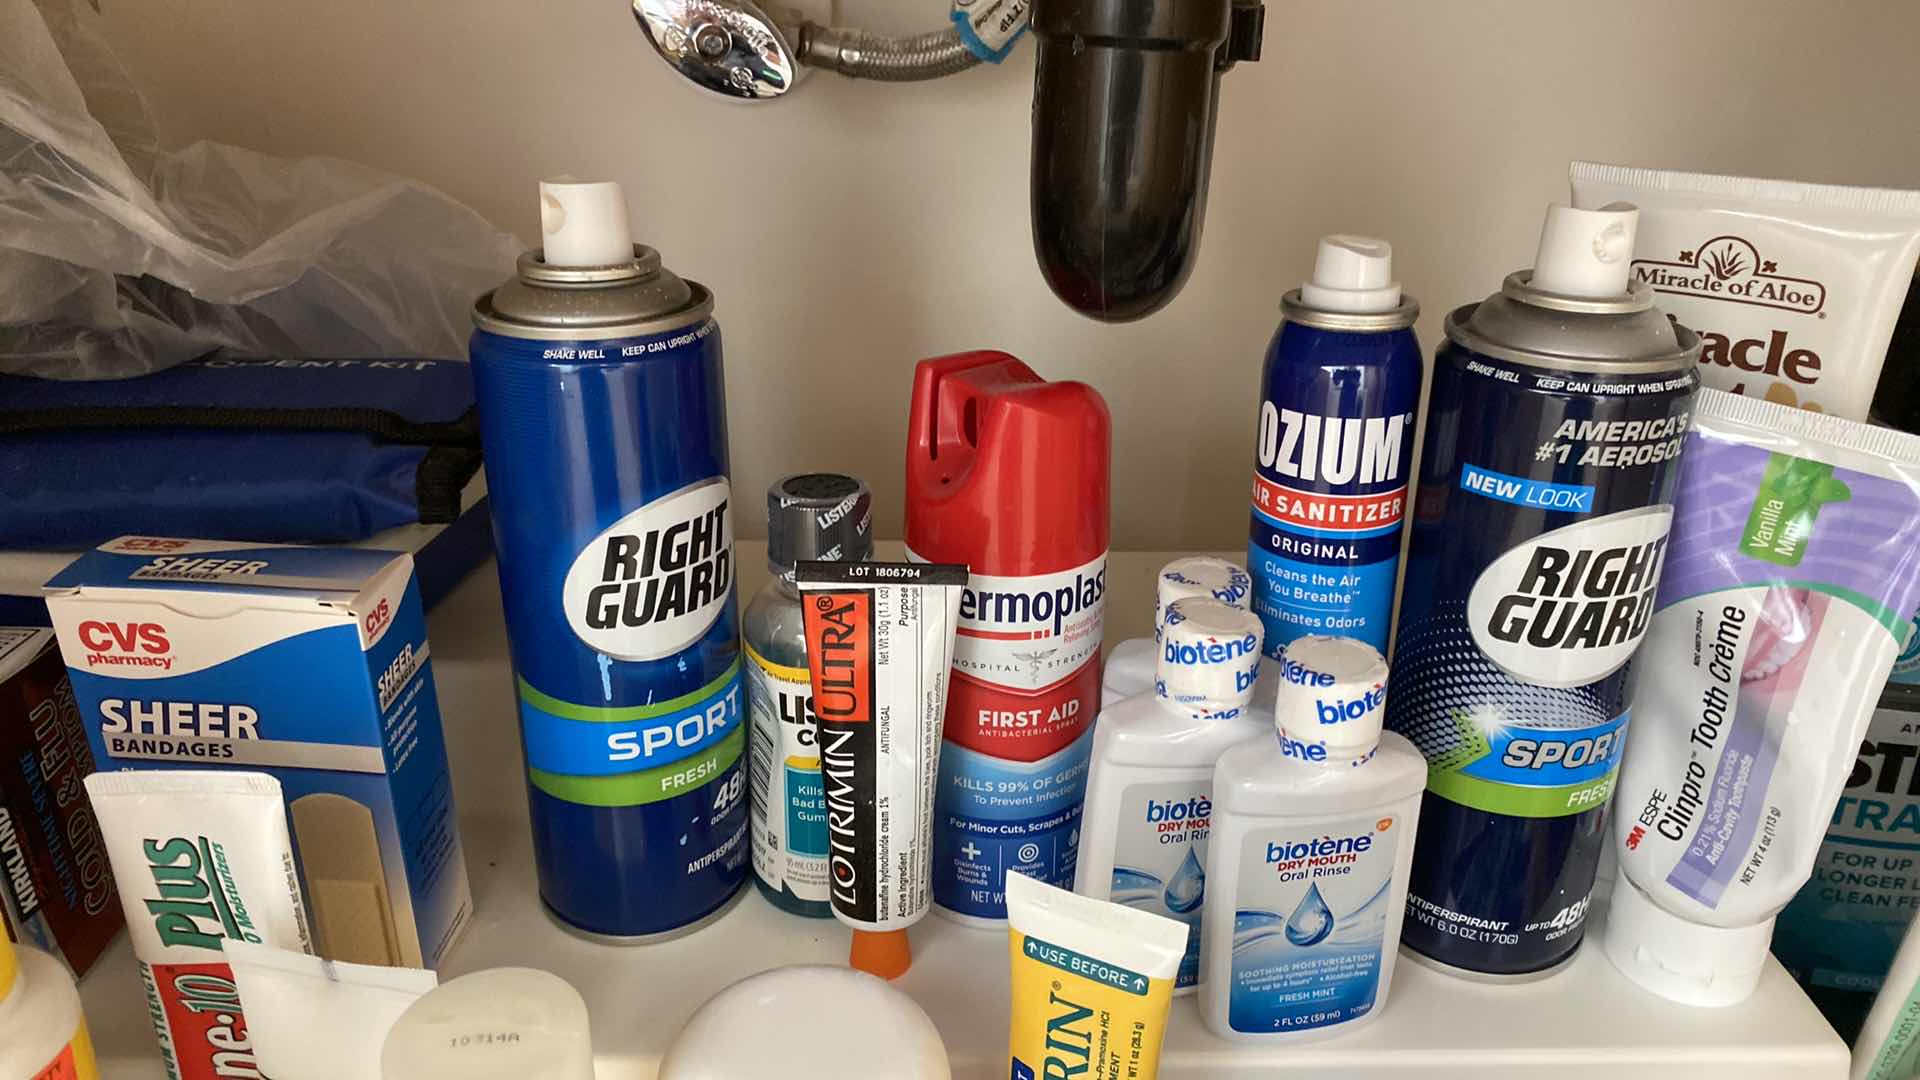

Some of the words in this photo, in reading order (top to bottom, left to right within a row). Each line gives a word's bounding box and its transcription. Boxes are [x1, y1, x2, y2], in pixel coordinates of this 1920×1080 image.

[1635, 266, 1723, 293] Miracle
[1728, 280, 1759, 298] of
[1757, 282, 1816, 307] Aloe
[543, 349, 576, 360] SHAKE
[577, 349, 606, 360] WELL
[621, 345, 647, 357] KEEP
[647, 341, 667, 353] CAN
[667, 333, 696, 349] UPRIGHT
[1465, 360, 1496, 379] SHAKE
[1494, 370, 1520, 384] WELL
[1536, 377, 1565, 390] KEEP
[1566, 381, 1590, 394] CAN
[1592, 382, 1635, 394] UPRIGHT
[1637, 381, 1664, 394] WHEN
[1553, 412, 1689, 442] AMERICA'S
[1258, 400, 1405, 486] OZIUM
[1535, 441, 1571, 465] #1
[1577, 440, 1684, 467] AEROSOL
[1465, 471, 1521, 500] NEW
[1525, 486, 1587, 509] LOOK
[1275, 495, 1401, 524] SANITIZER
[1749, 498, 1784, 549] Vanilla
[601, 499, 728, 583] RIGHT
[1271, 533, 1359, 560] ORIGINAL
[1774, 519, 1801, 557] Mint
[144, 556, 270, 575] SHEER
[849, 567, 870, 577] LOT
[875, 567, 921, 578] 1806794
[1265, 560, 1308, 584] Cleans
[1312, 573, 1330, 587] the
[1338, 573, 1361, 587] Air
[1517, 533, 1669, 599] RIGHT
[585, 547, 729, 630] GUARD
[877, 586, 891, 600] oz)
[1268, 579, 1290, 596] You
[1293, 587, 1352, 604] Breathe
[366, 597, 390, 634] CVS
[877, 602, 892, 618] (1.1
[898, 587, 911, 627] Purpose
[1487, 586, 1657, 650] GUARD
[877, 620, 891, 637] 30g
[1325, 616, 1366, 628] Odors
[78, 620, 171, 655] CVS
[877, 638, 889, 651] Wt
[1164, 634, 1258, 666] biotène
[1708, 605, 1747, 684] Crème
[86, 653, 173, 670] pharmacy
[377, 642, 414, 693] SHEER
[821, 601, 857, 716] ULTRA
[877, 651, 889, 666] Net
[952, 657, 1022, 673] HOSPITAL
[99, 698, 261, 740] SHEER
[608, 685, 739, 761] SPORT
[978, 709, 1043, 729] FIRST
[1047, 699, 1080, 724] AID
[1690, 685, 1729, 749] Tooth
[29, 698, 70, 782] FLU
[880, 705, 890, 754] ANTIFUNGAL
[978, 727, 1053, 738] ANTIBACTERIAL
[112, 737, 234, 759] BANDAGES
[1502, 724, 1625, 770] SPORT
[661, 759, 718, 792] FRESH
[1718, 749, 1741, 790] Fluoride
[57, 775, 81, 808] &
[798, 786, 823, 797] Kills
[952, 776, 995, 793] KILLS
[997, 782, 1030, 794] 99%
[1032, 776, 1053, 791] OF
[792, 797, 815, 809] Bad
[879, 796, 890, 809] 1%
[973, 793, 988, 805] To
[990, 796, 1034, 807] Prevent
[1656, 760, 1706, 842] Clinpro
[1705, 808, 1741, 866] Anti-Cavity
[1727, 754, 1754, 808] Toothpaste
[1708, 790, 1730, 824] Sodium
[823, 728, 857, 906] LOTRIMIN
[880, 810, 890, 834] cream
[950, 817, 967, 830] For
[968, 823, 998, 835] Minor
[1000, 824, 1027, 835] Cuts,
[1028, 815, 1065, 833] Scrapes
[1157, 821, 1186, 833] DRY
[1625, 825, 1647, 851] 3M
[1639, 788, 1668, 827] ESPE
[1765, 815, 1779, 837] (113
[1159, 830, 1188, 845] Oral
[1265, 834, 1372, 865] biotène
[1761, 844, 1767, 853] 4
[1762, 836, 1772, 847] oz
[0, 806, 39, 916] KIRKLAND
[67, 807, 112, 916] COLD
[879, 834, 891, 884] hydrochloride
[953, 858, 993, 872] Disinfects
[1277, 859, 1306, 872] DRY
[1307, 853, 1358, 870] MOUTH
[1751, 851, 1763, 867] WT
[1832, 851, 1877, 869] FOR
[1883, 856, 1913, 871] UP
[211, 841, 256, 930] Moisturizers
[897, 853, 908, 893] Ingredient
[956, 874, 989, 887] Wounds
[957, 867, 981, 879] Burns
[1279, 869, 1309, 883] Oral
[1313, 866, 1351, 878] Rinse
[1739, 866, 1756, 887] NET
[1818, 867, 1907, 891] LONGER
[143, 836, 227, 952] Plus
[897, 893, 907, 918] Active
[970, 890, 990, 904] NET
[1822, 887, 1892, 907] CLEAN
[1417, 910, 1437, 928] WT
[1437, 919, 1458, 936] 6.0
[1460, 927, 1479, 941] OZ
[1479, 931, 1520, 946] (170G)
[1524, 923, 1539, 932] UP
[1538, 921, 1551, 932] TO
[1545, 928, 1568, 942] ODOR
[1039, 948, 1068, 966] USE
[1070, 956, 1129, 987] BEFORE
[1238, 964, 1290, 979] SOOTHING
[1291, 952, 1376, 971] MOISTURIZATION
[137, 959, 170, 1043] STRENGTH
[1279, 991, 1311, 1003] FRESH
[1312, 987, 1336, 999] MINT
[1273, 1017, 1281, 1027] 2
[1282, 1016, 1294, 1026] FL
[1295, 1014, 1309, 1024] OZ
[1310, 1012, 1326, 1024] (59
[1131, 1031, 1144, 1050] (28.3
[1131, 1048, 1141, 1060] oz
[1126, 1064, 1138, 1079] WT
